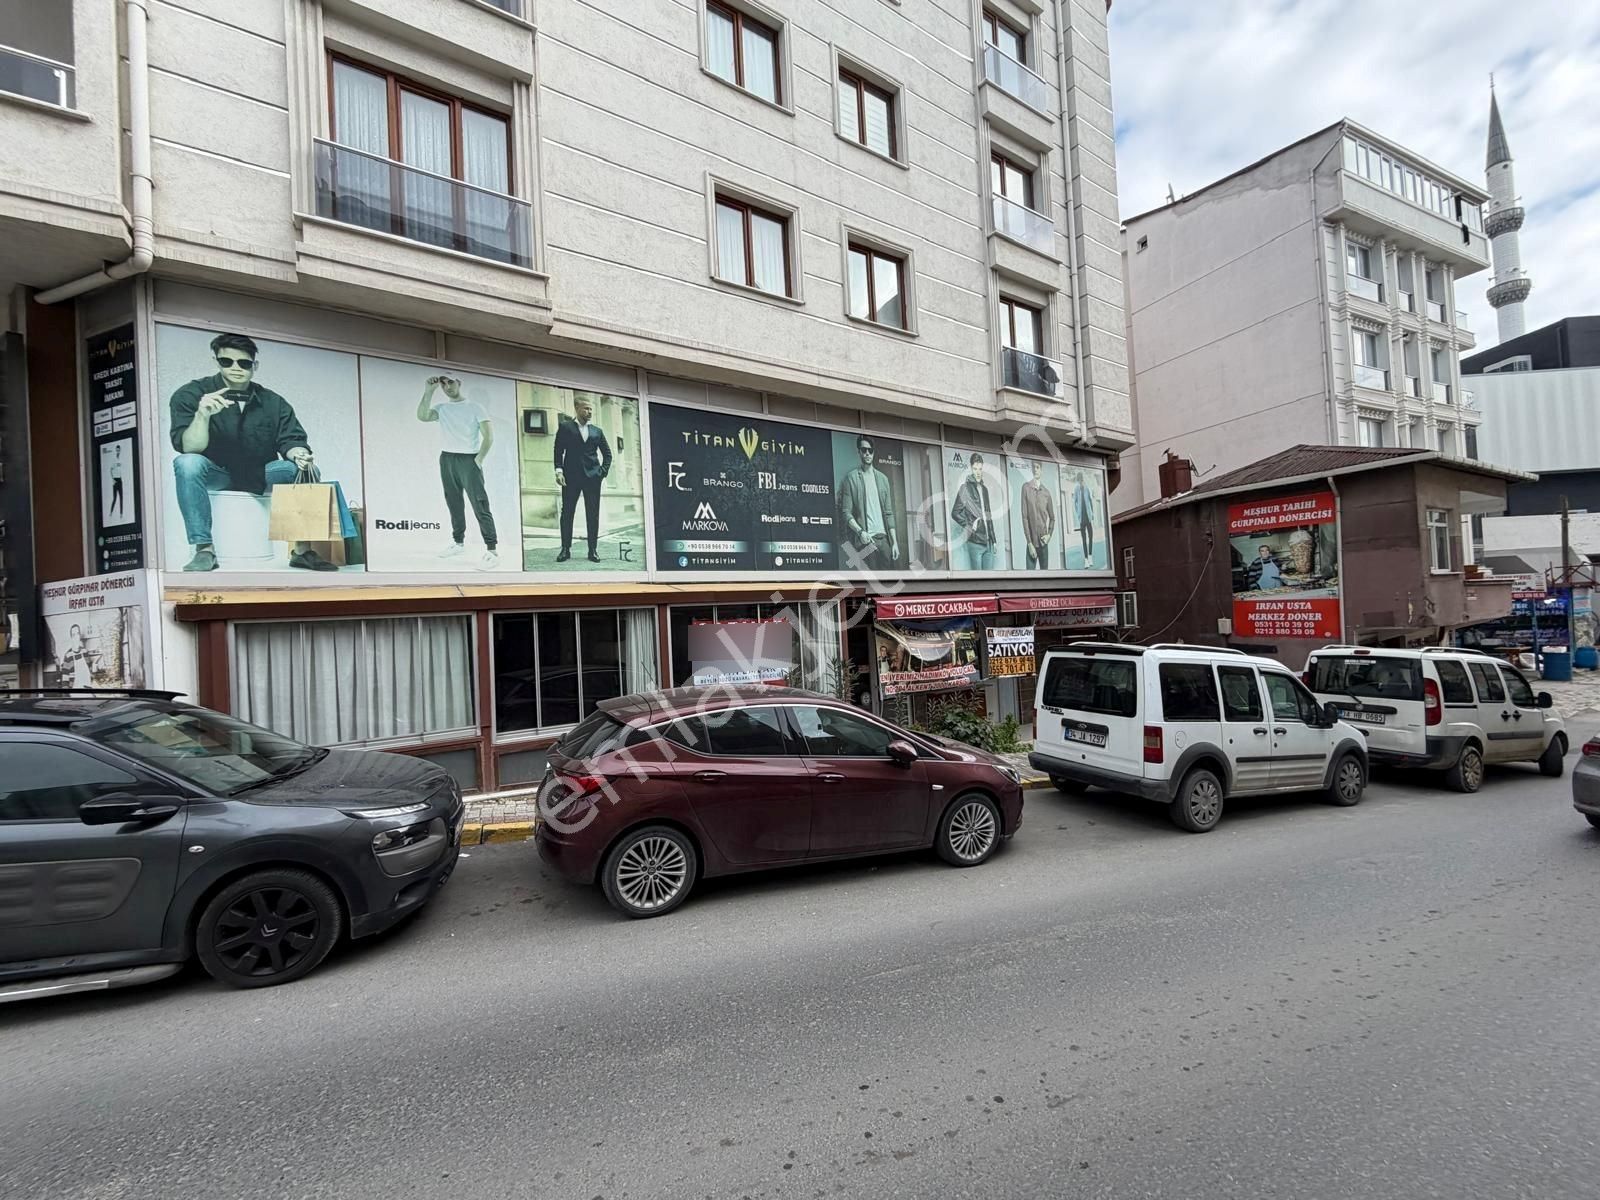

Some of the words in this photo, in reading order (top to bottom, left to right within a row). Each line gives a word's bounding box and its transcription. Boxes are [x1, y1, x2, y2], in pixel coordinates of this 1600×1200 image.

[682, 430, 735, 448] TİTAN
[761, 439, 805, 456] GİYİM
[703, 478, 744, 488] BRANGO
[757, 471, 777, 490] FBI
[1243, 505, 1280, 517] MEŞHUR
[682, 520, 729, 532] MARKOVA
[691, 556, 736, 565] TİTANGİYİM
[88, 595, 105, 607] USTA
[1287, 601, 1312, 610] USTA
[905, 603, 936, 615] MERKEZ
[937, 602, 974, 614] OCAKBAŞI
[1247, 613, 1286, 621] MERKEZ
[988, 643, 1034, 657] SATIYOR
[1089, 733, 1105, 744] 1297
